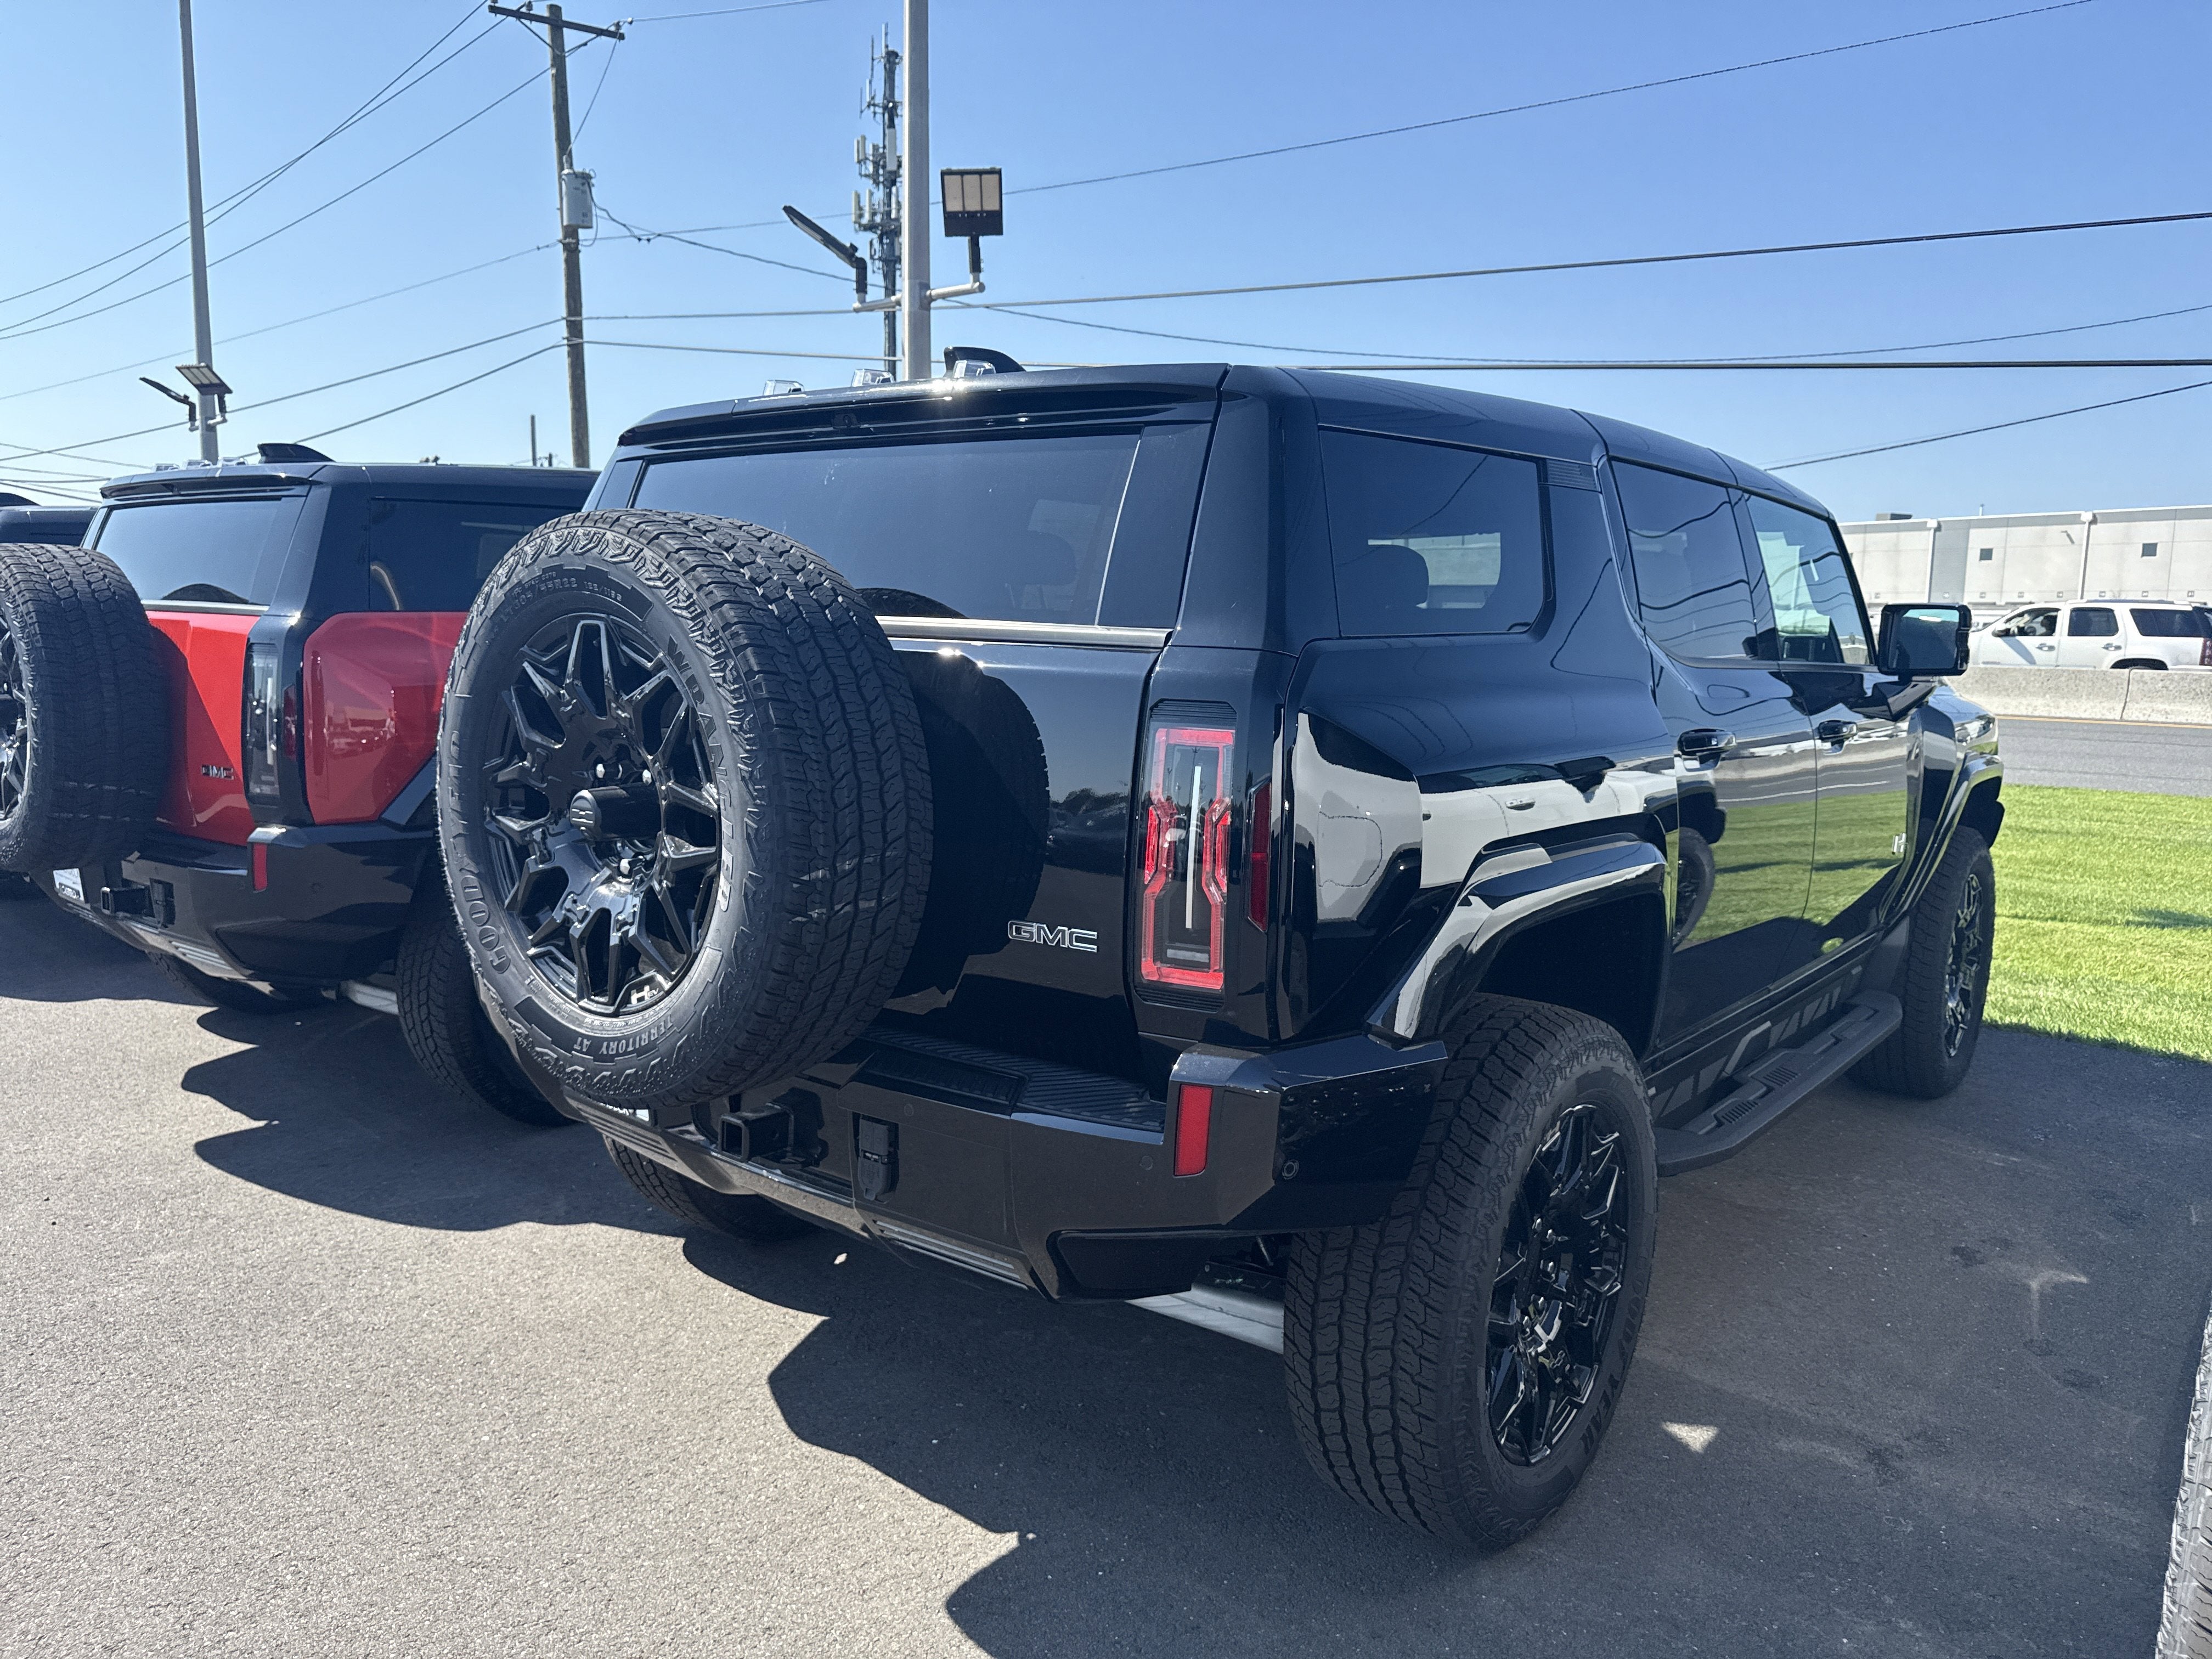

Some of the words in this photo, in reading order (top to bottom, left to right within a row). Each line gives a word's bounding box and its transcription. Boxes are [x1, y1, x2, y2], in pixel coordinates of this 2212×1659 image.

[201, 764, 234, 780] GMC
[667, 633, 733, 911] WRANGLER
[1008, 920, 1097, 952] GMC
[574, 1037, 591, 1052] AT
[600, 1014, 673, 1054] TERRITORY
